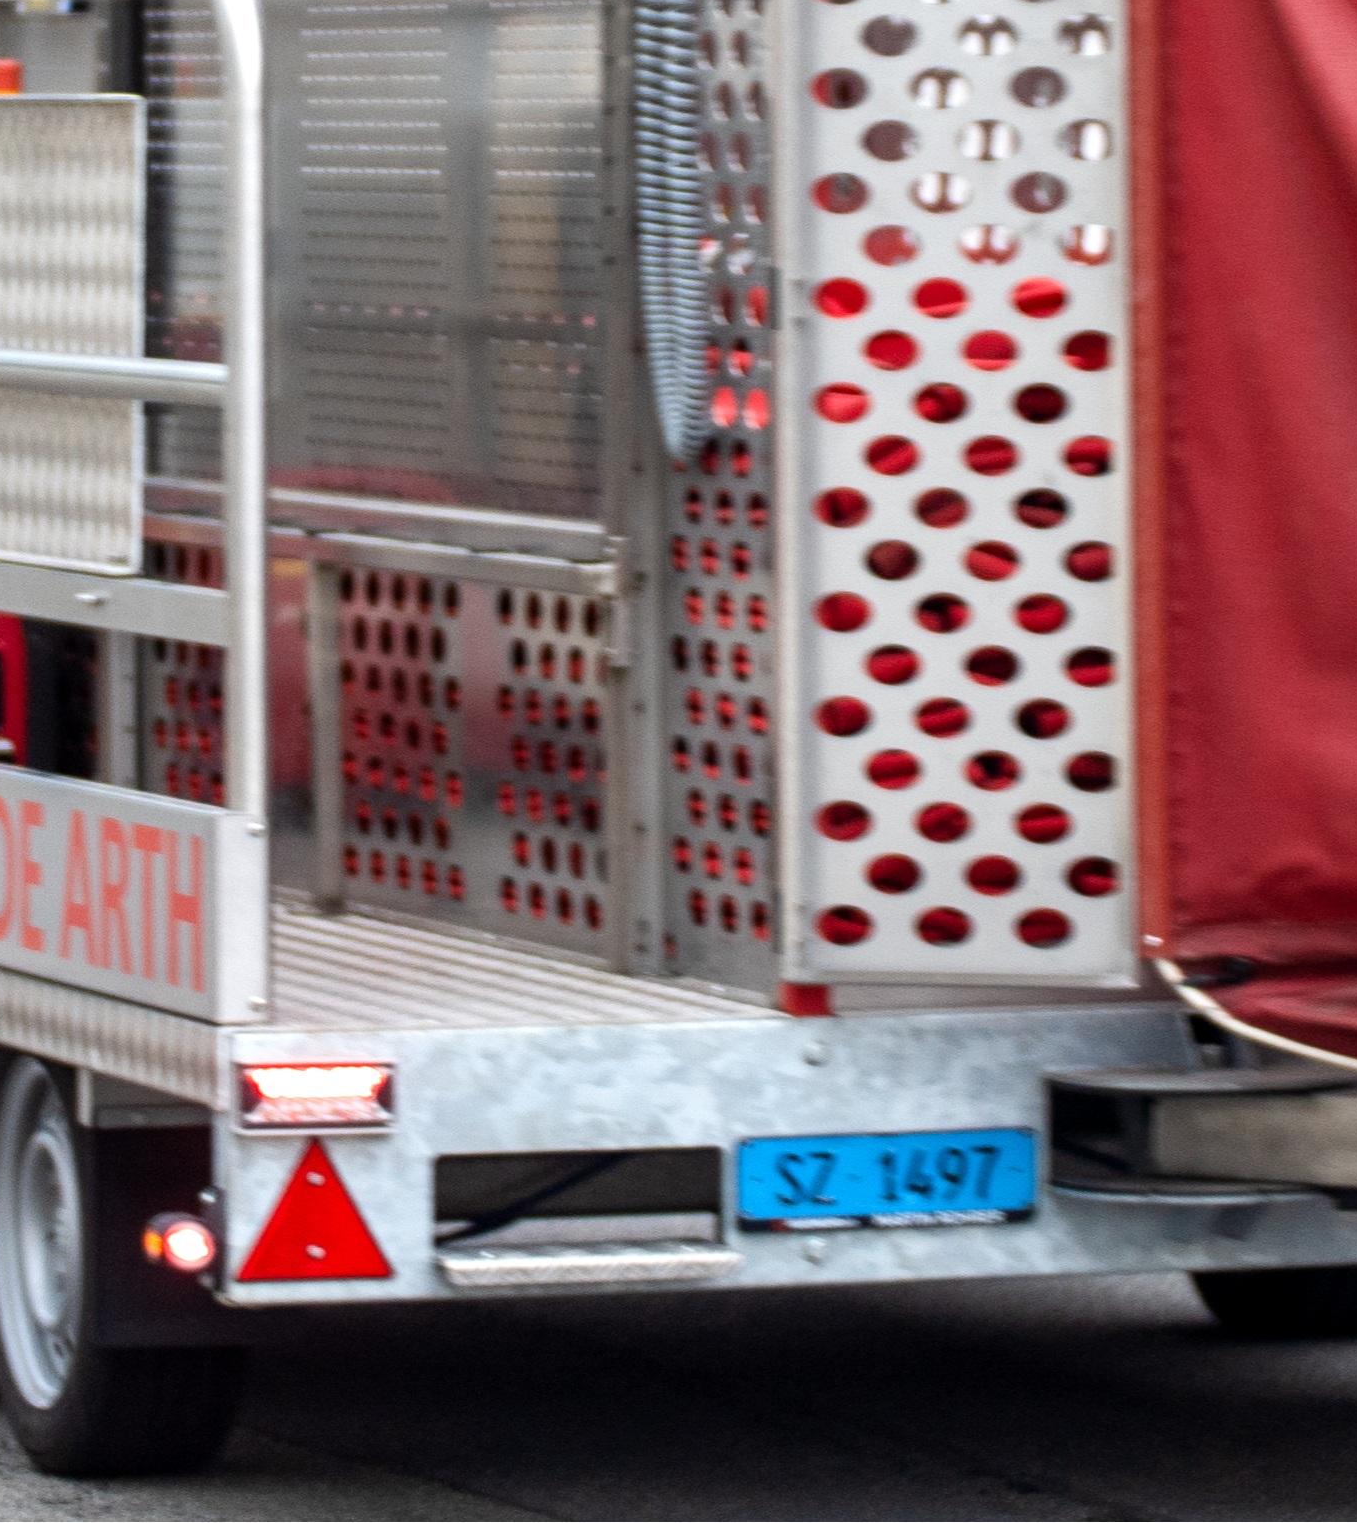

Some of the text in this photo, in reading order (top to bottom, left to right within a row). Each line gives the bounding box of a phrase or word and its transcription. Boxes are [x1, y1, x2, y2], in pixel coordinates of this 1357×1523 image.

[59, 810, 205, 992] ARTH
[775, 1145, 1000, 1205] SZ 1497
